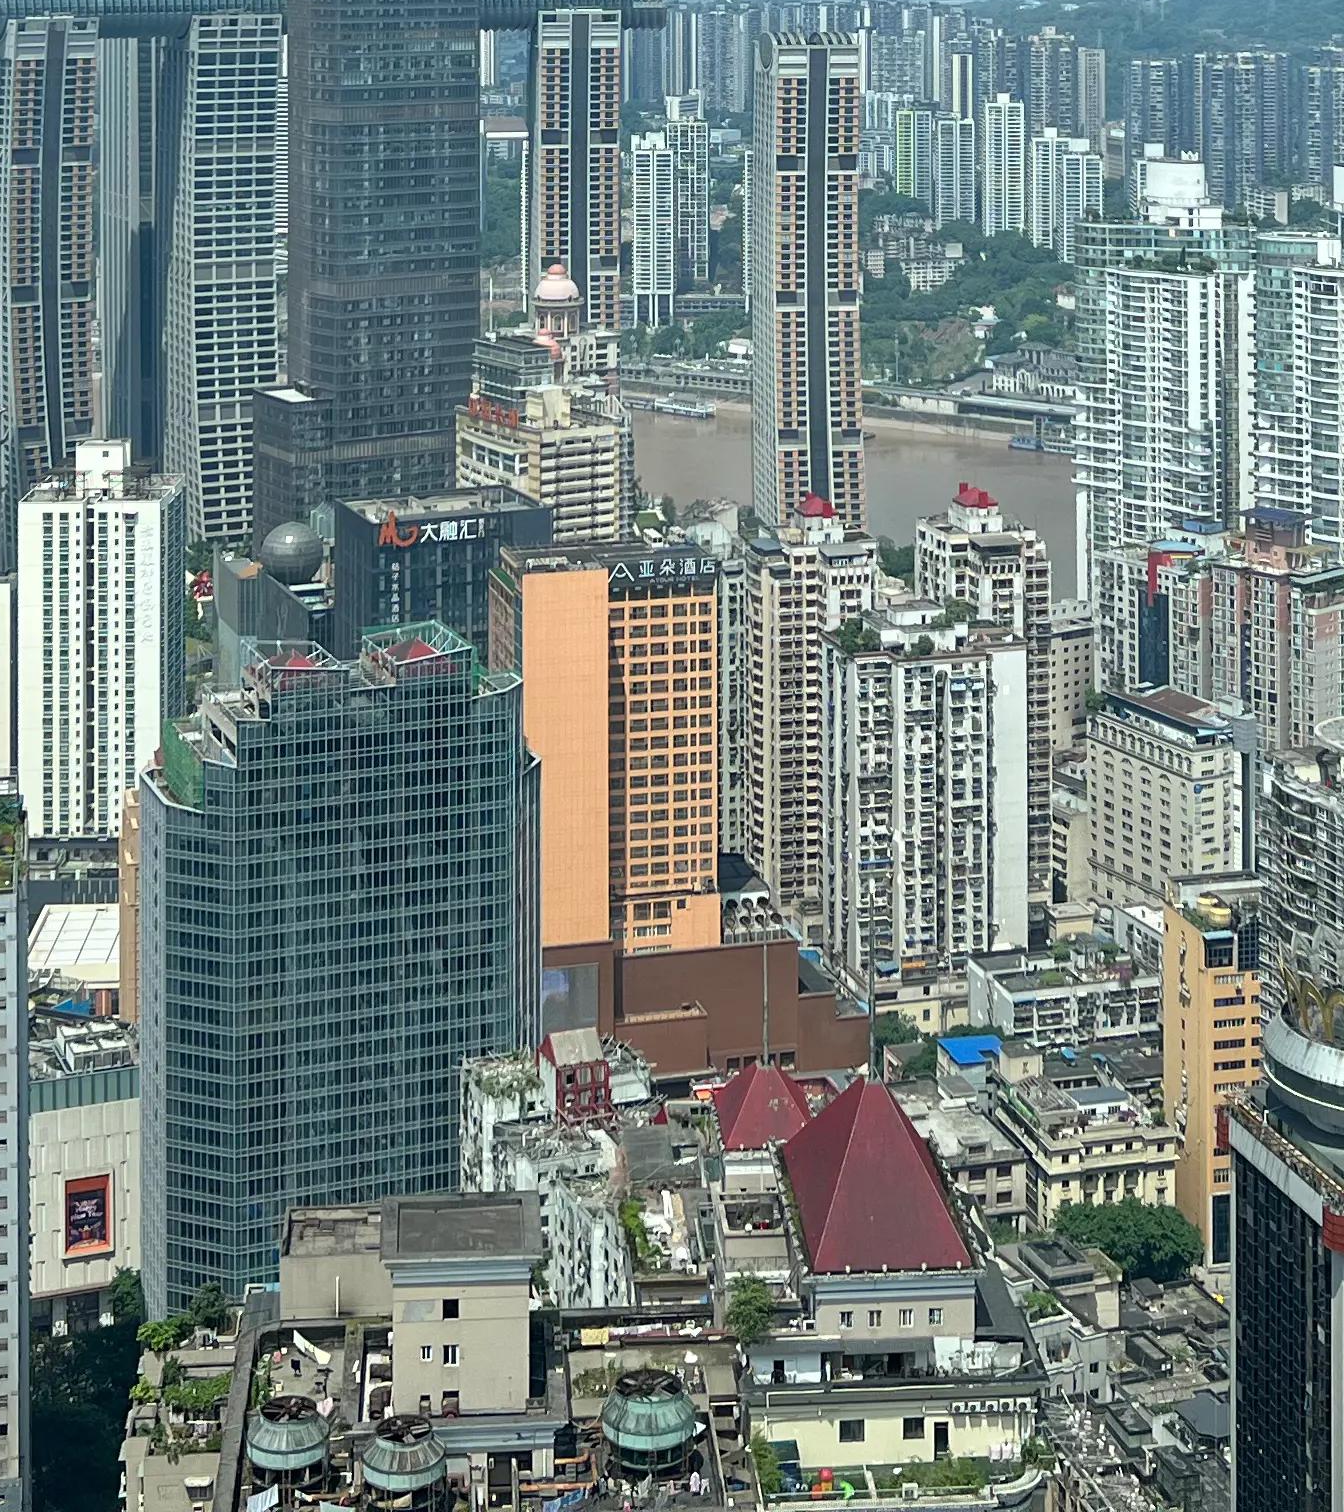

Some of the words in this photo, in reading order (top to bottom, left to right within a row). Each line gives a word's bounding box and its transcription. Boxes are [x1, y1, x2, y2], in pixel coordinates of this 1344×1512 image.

[420, 518, 477, 544] 大融汇
[638, 557, 716, 578] 亚朵酒店
